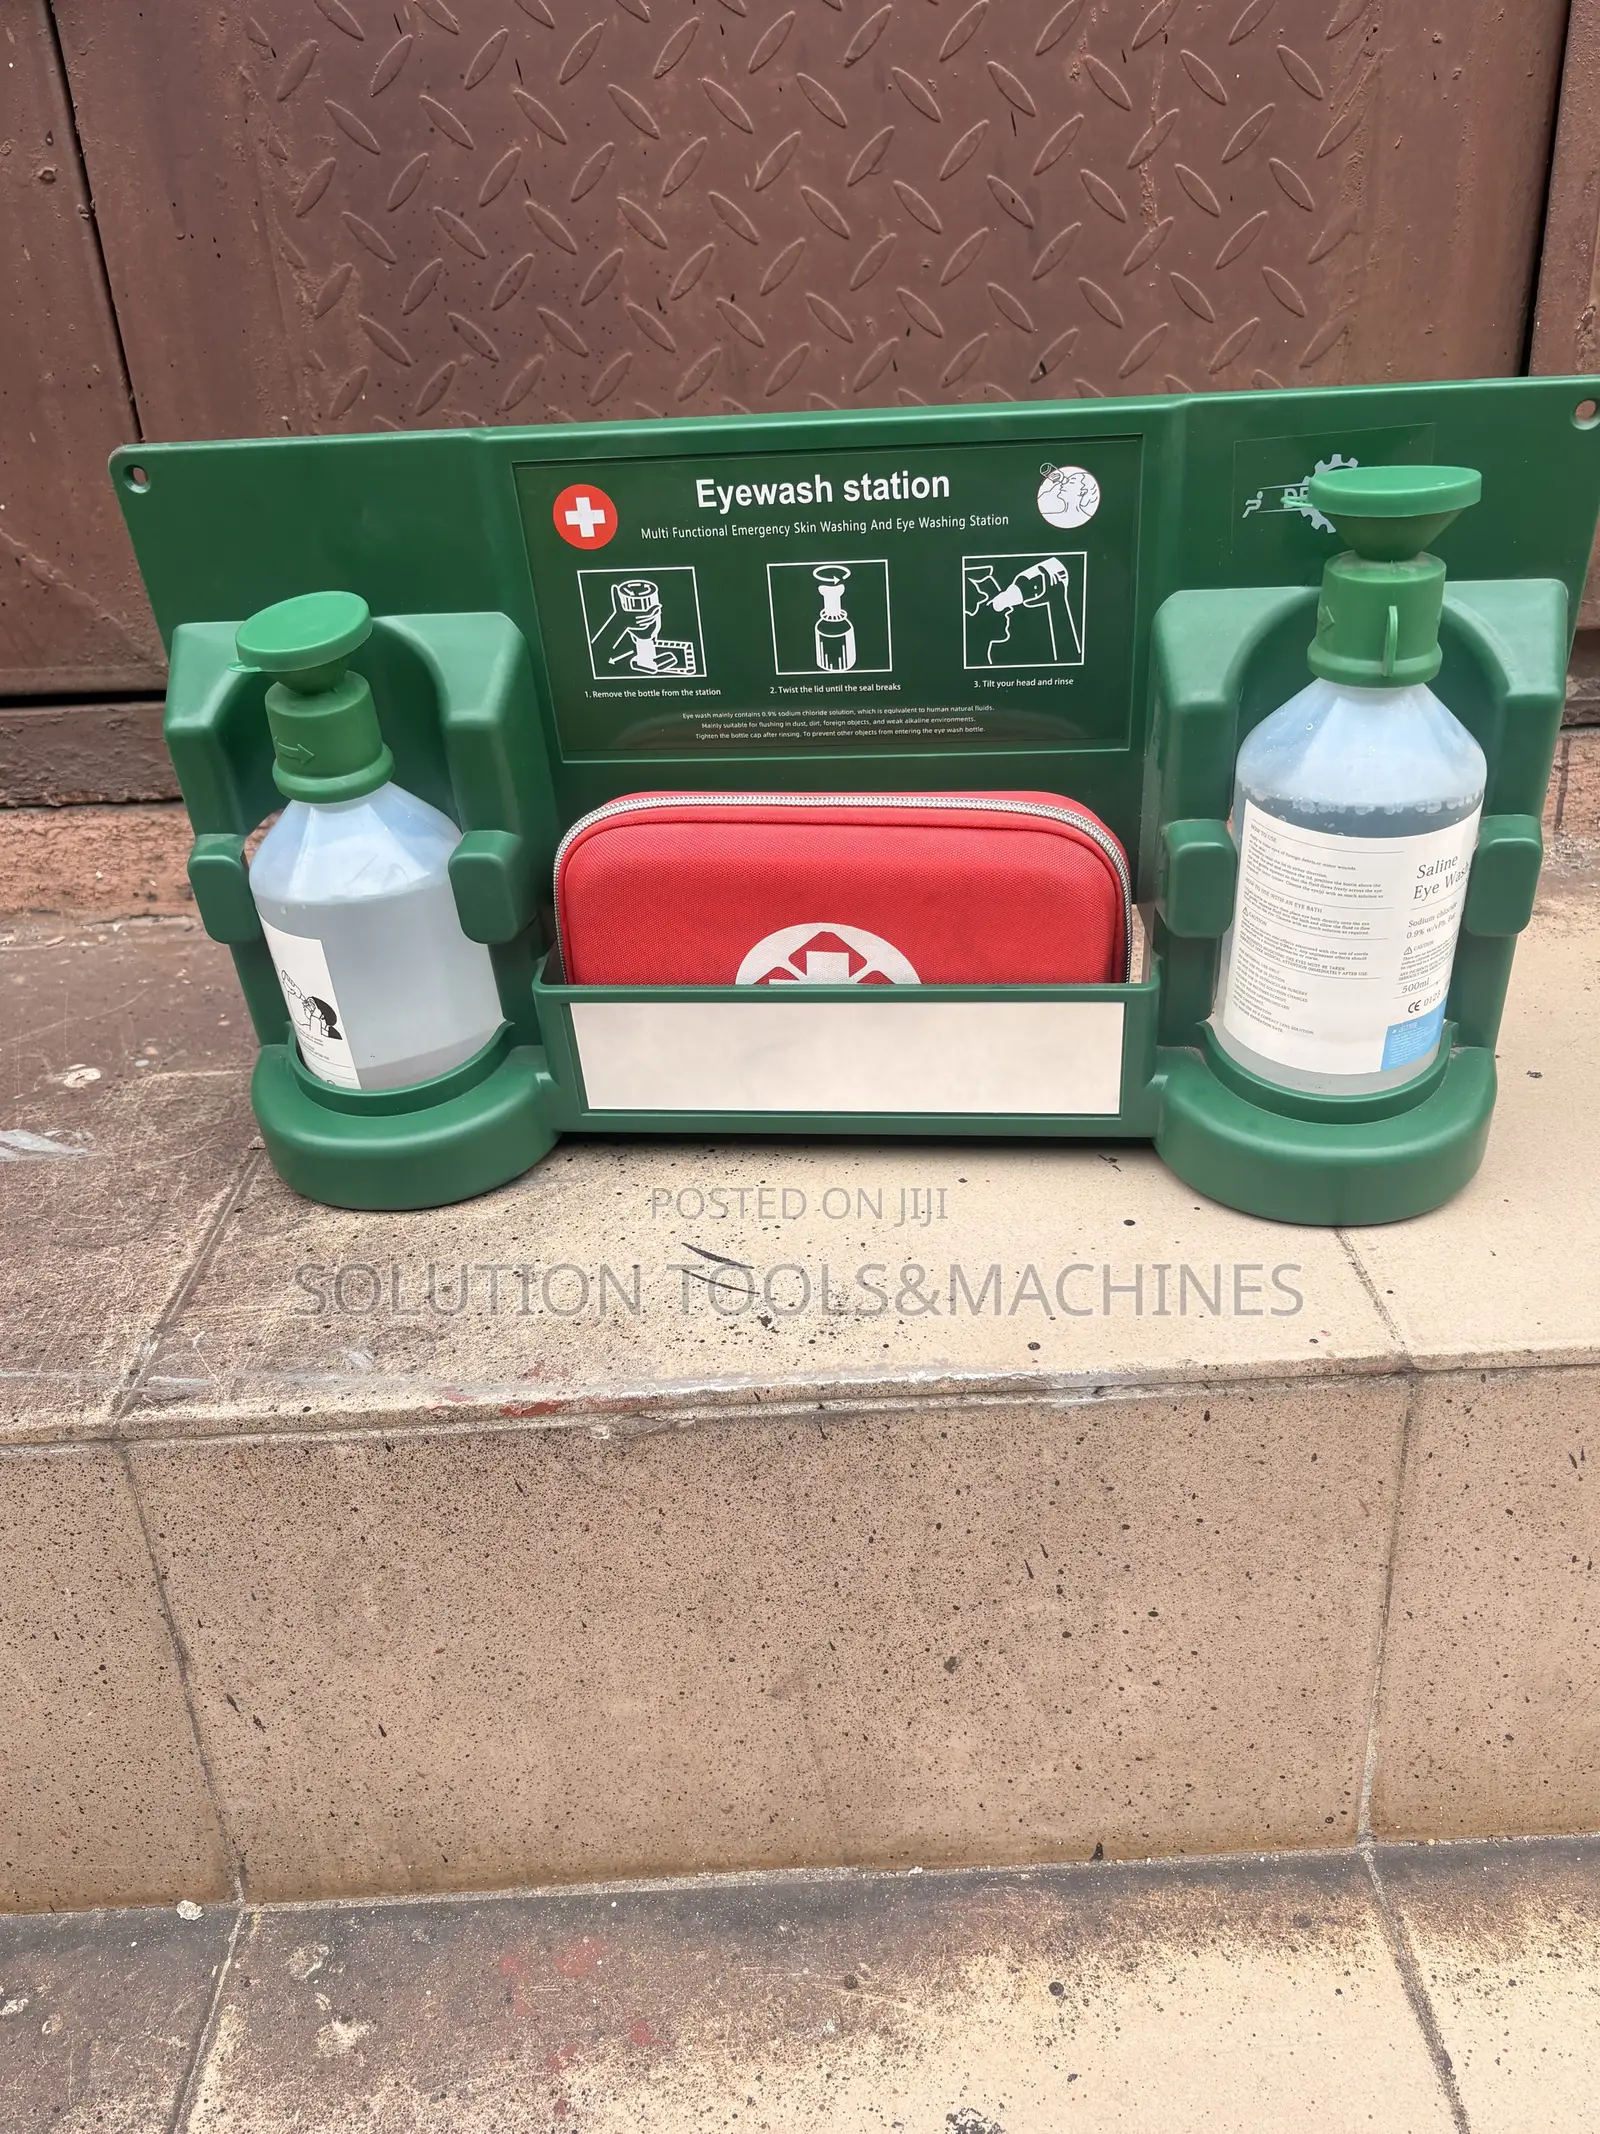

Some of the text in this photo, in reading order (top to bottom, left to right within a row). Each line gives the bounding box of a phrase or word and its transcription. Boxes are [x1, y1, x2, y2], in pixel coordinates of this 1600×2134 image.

[696, 470, 950, 515] Eyewash station
[641, 514, 1009, 540] Multi Functional Emergency Skin Washing And Eye Washing Station
[769, 683, 902, 694] 2. Twist the lid until the seal breaks
[973, 677, 1074, 689] 3. Tilt your head and rinse
[592, 690, 623, 698] Remove
[623, 690, 637, 698] the
[637, 689, 661, 697] bottle
[661, 688, 680, 697] from
[680, 688, 694, 696] the
[695, 688, 722, 696] station
[682, 712, 694, 720] Eye
[712, 711, 734, 719] mainly
[828, 708, 856, 716] solution,
[883, 707, 917, 715] equivalent
[701, 722, 722, 730] Mainly
[723, 721, 748, 729] suitable
[758, 721, 784, 729] flushing
[792, 720, 808, 728] dust,
[823, 719, 846, 727] foreign
[847, 719, 872, 727] objects,
[930, 716, 977, 724] environments.
[750, 732, 762, 740] cap
[778, 731, 802, 739] rinsing.
[812, 730, 836, 738] prevent
[854, 729, 878, 737] objects
[894, 728, 922, 736] entering
[1416, 855, 1459, 879] Saline
[1413, 861, 1469, 902] Eye Wash
[1408, 915, 1435, 928] Sodium
[1406, 929, 1425, 939] 0.9%
[1401, 977, 1430, 994] 500ml
[1407, 999, 1422, 1014] CE
